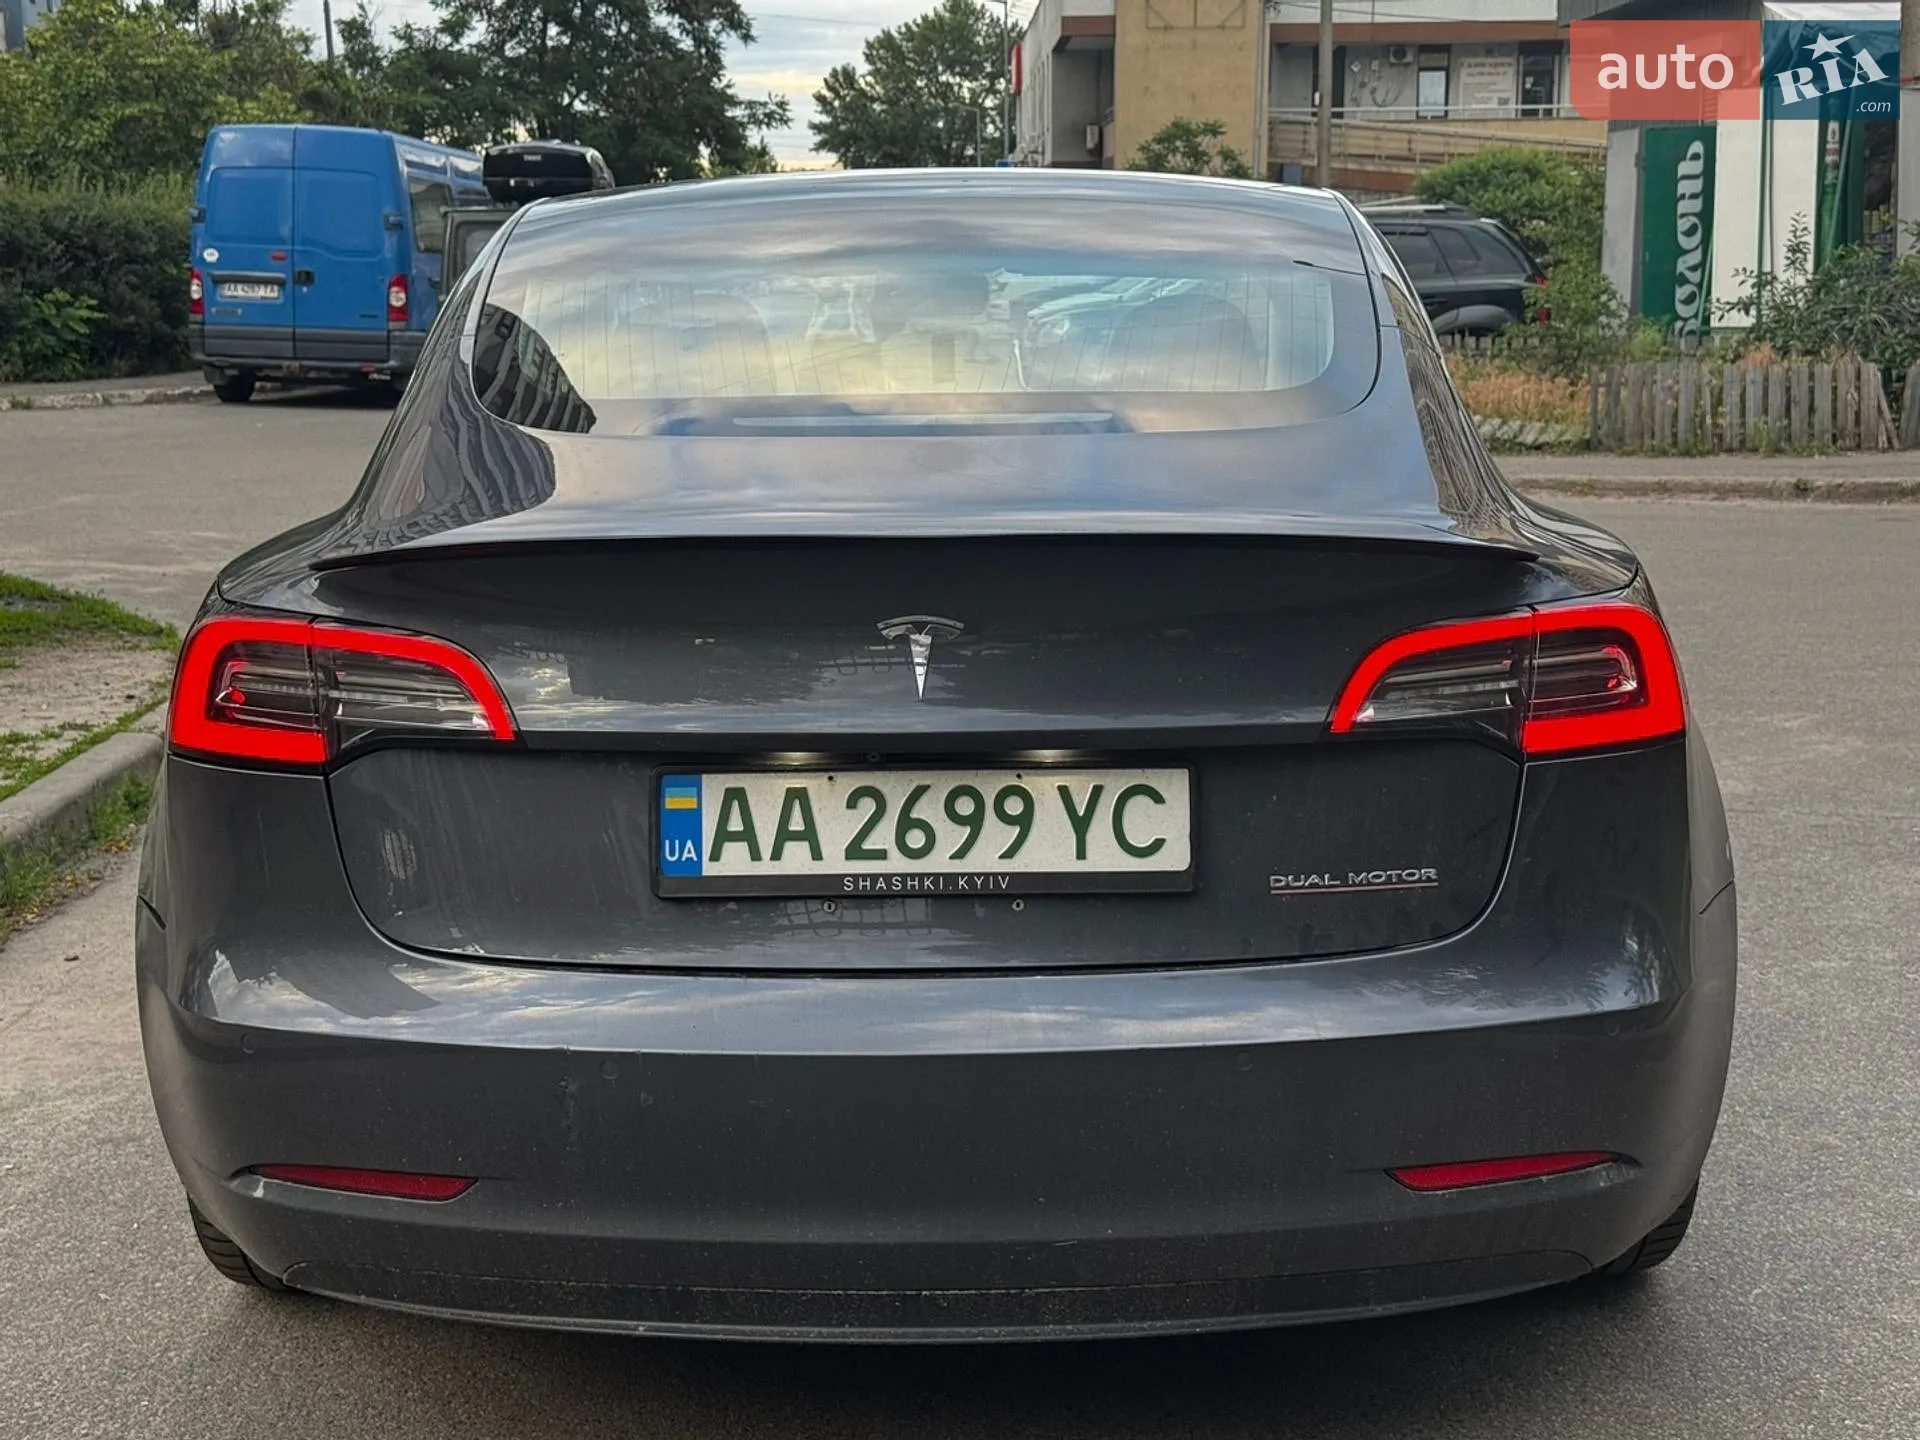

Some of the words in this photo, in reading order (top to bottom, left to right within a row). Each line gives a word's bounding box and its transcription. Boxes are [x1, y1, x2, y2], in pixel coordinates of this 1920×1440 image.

[708, 786, 824, 862] AA
[844, 783, 1035, 861] 2699
[1057, 783, 1167, 860] YC
[664, 839, 698, 862] UA
[843, 875, 1010, 891] SHASHKI.KYIV
[1270, 873, 1341, 887] DUAL
[1348, 868, 1438, 884] MOTOR
